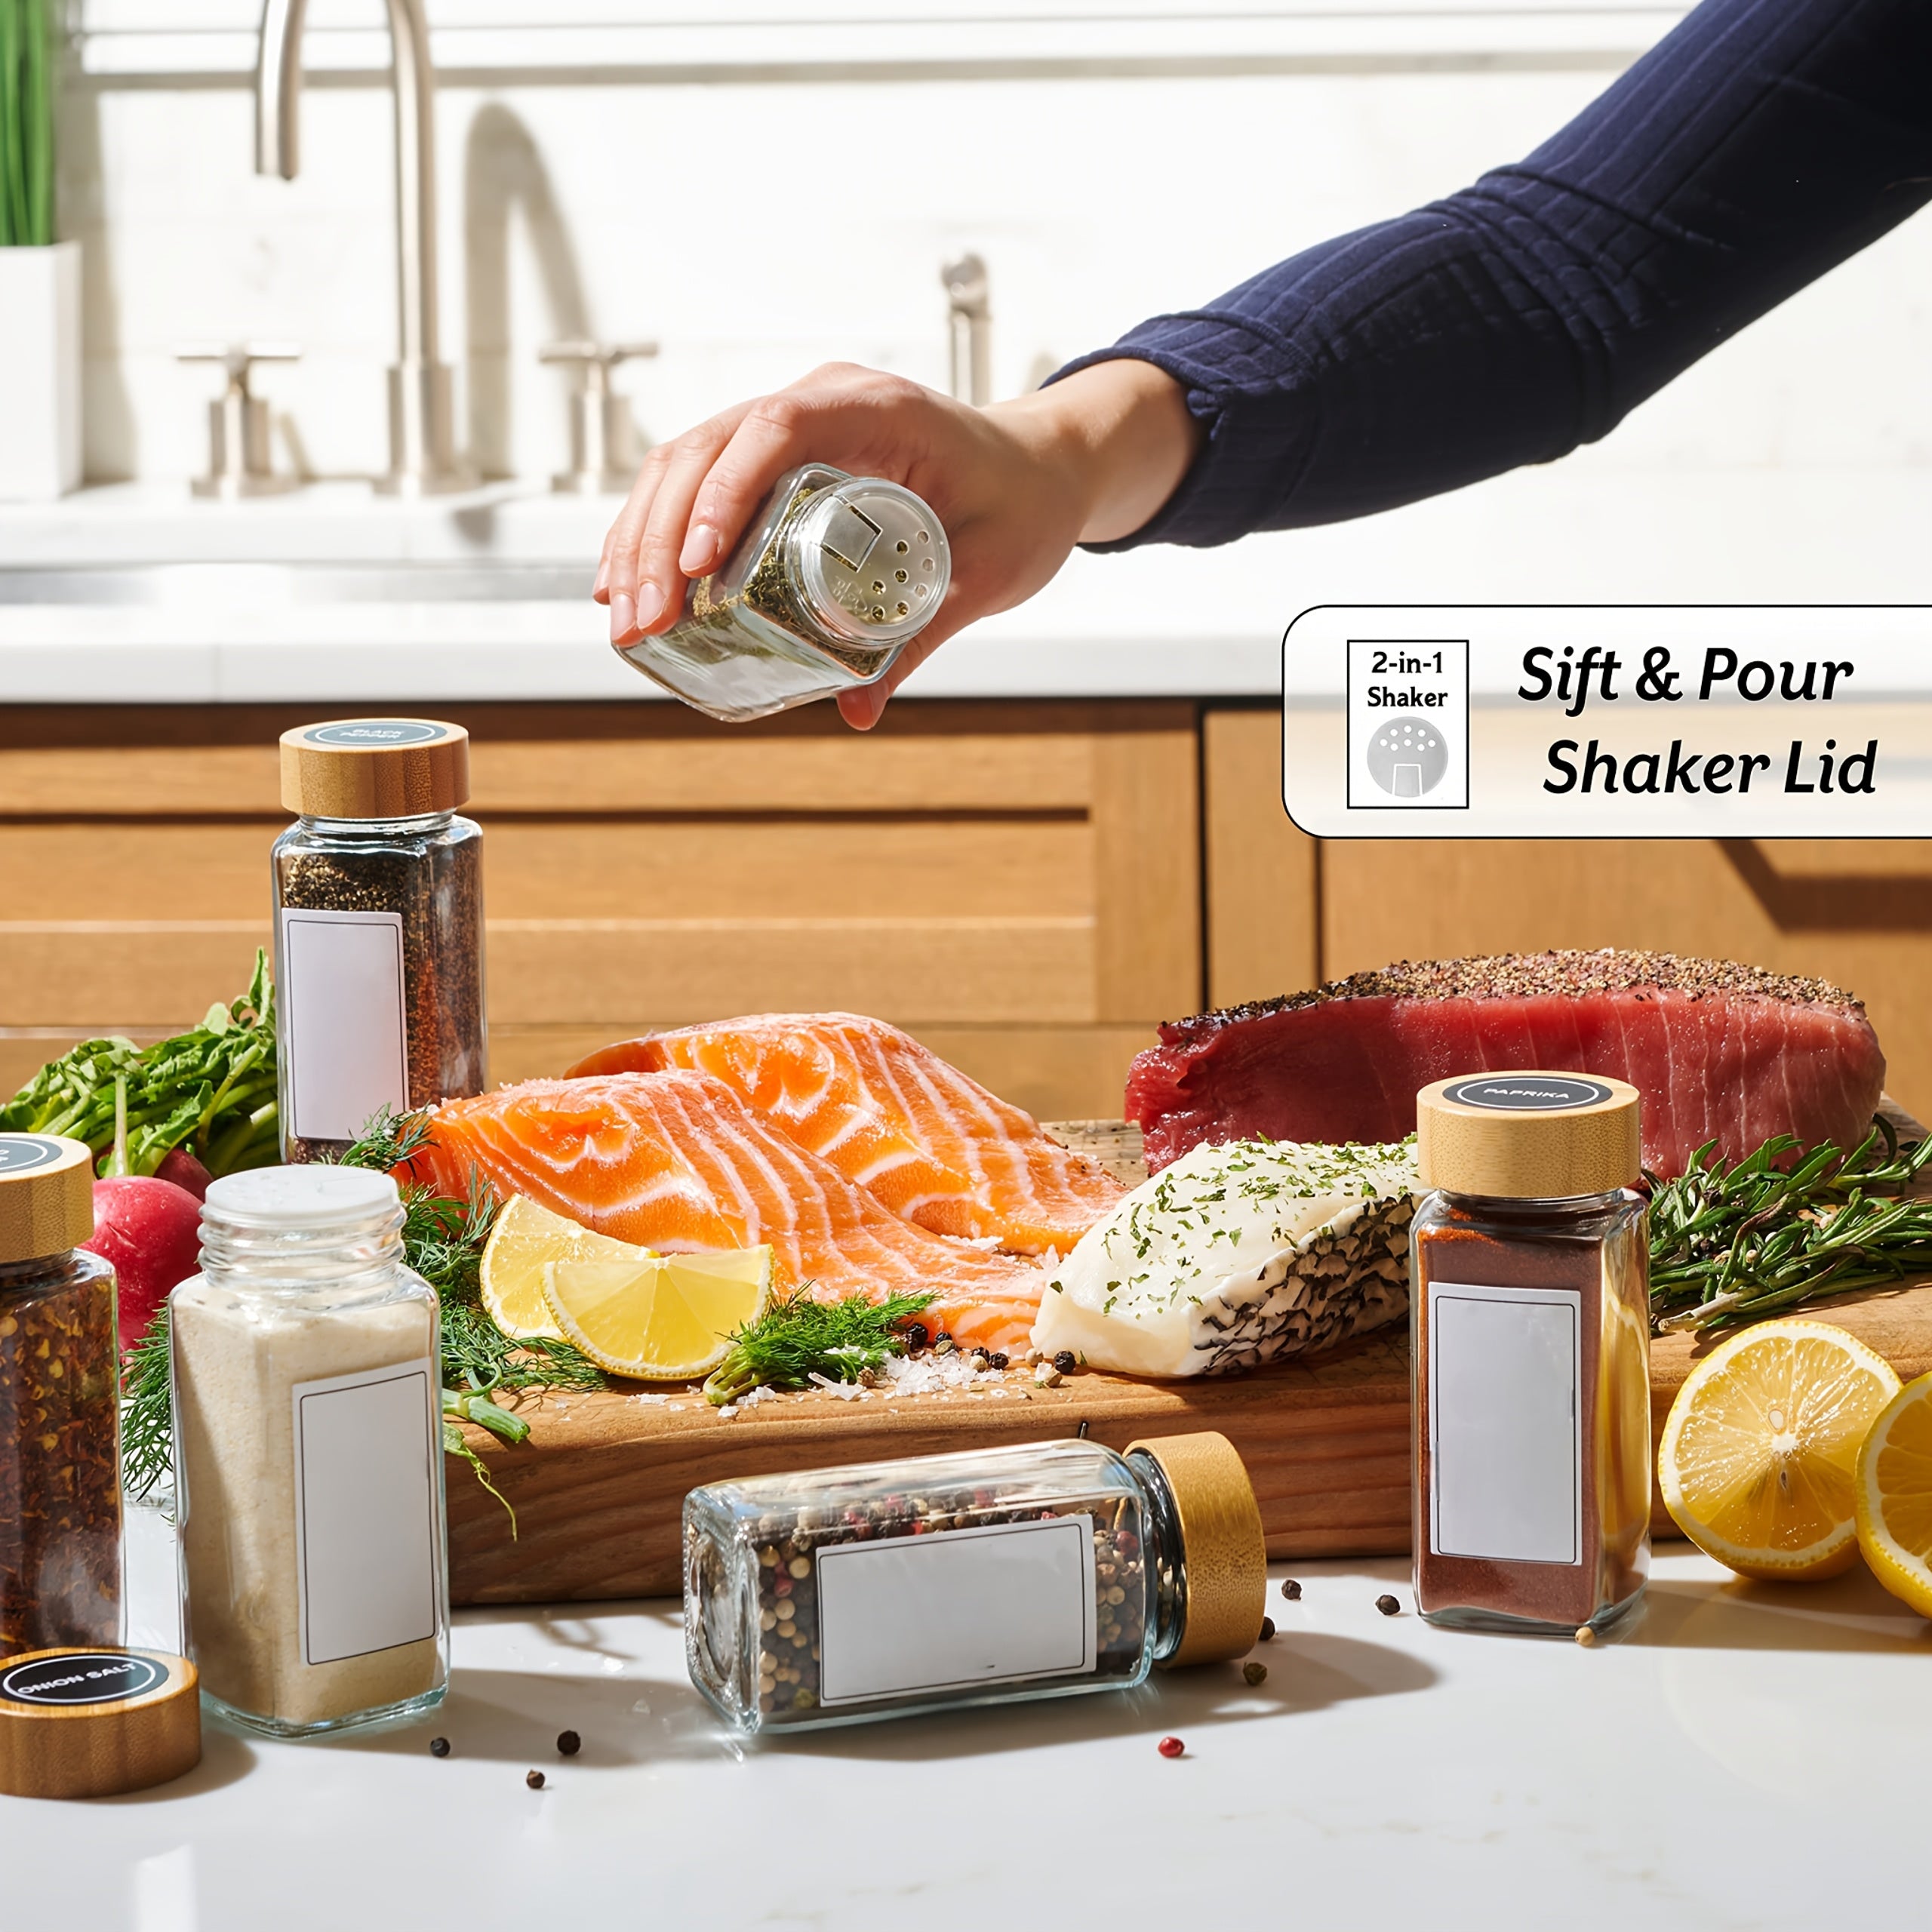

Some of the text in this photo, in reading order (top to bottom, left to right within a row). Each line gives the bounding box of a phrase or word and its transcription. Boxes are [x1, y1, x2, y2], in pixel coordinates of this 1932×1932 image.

[1483, 1088, 1570, 1099] PAPRIKA
[17, 1663, 136, 1694] ONION SALT
